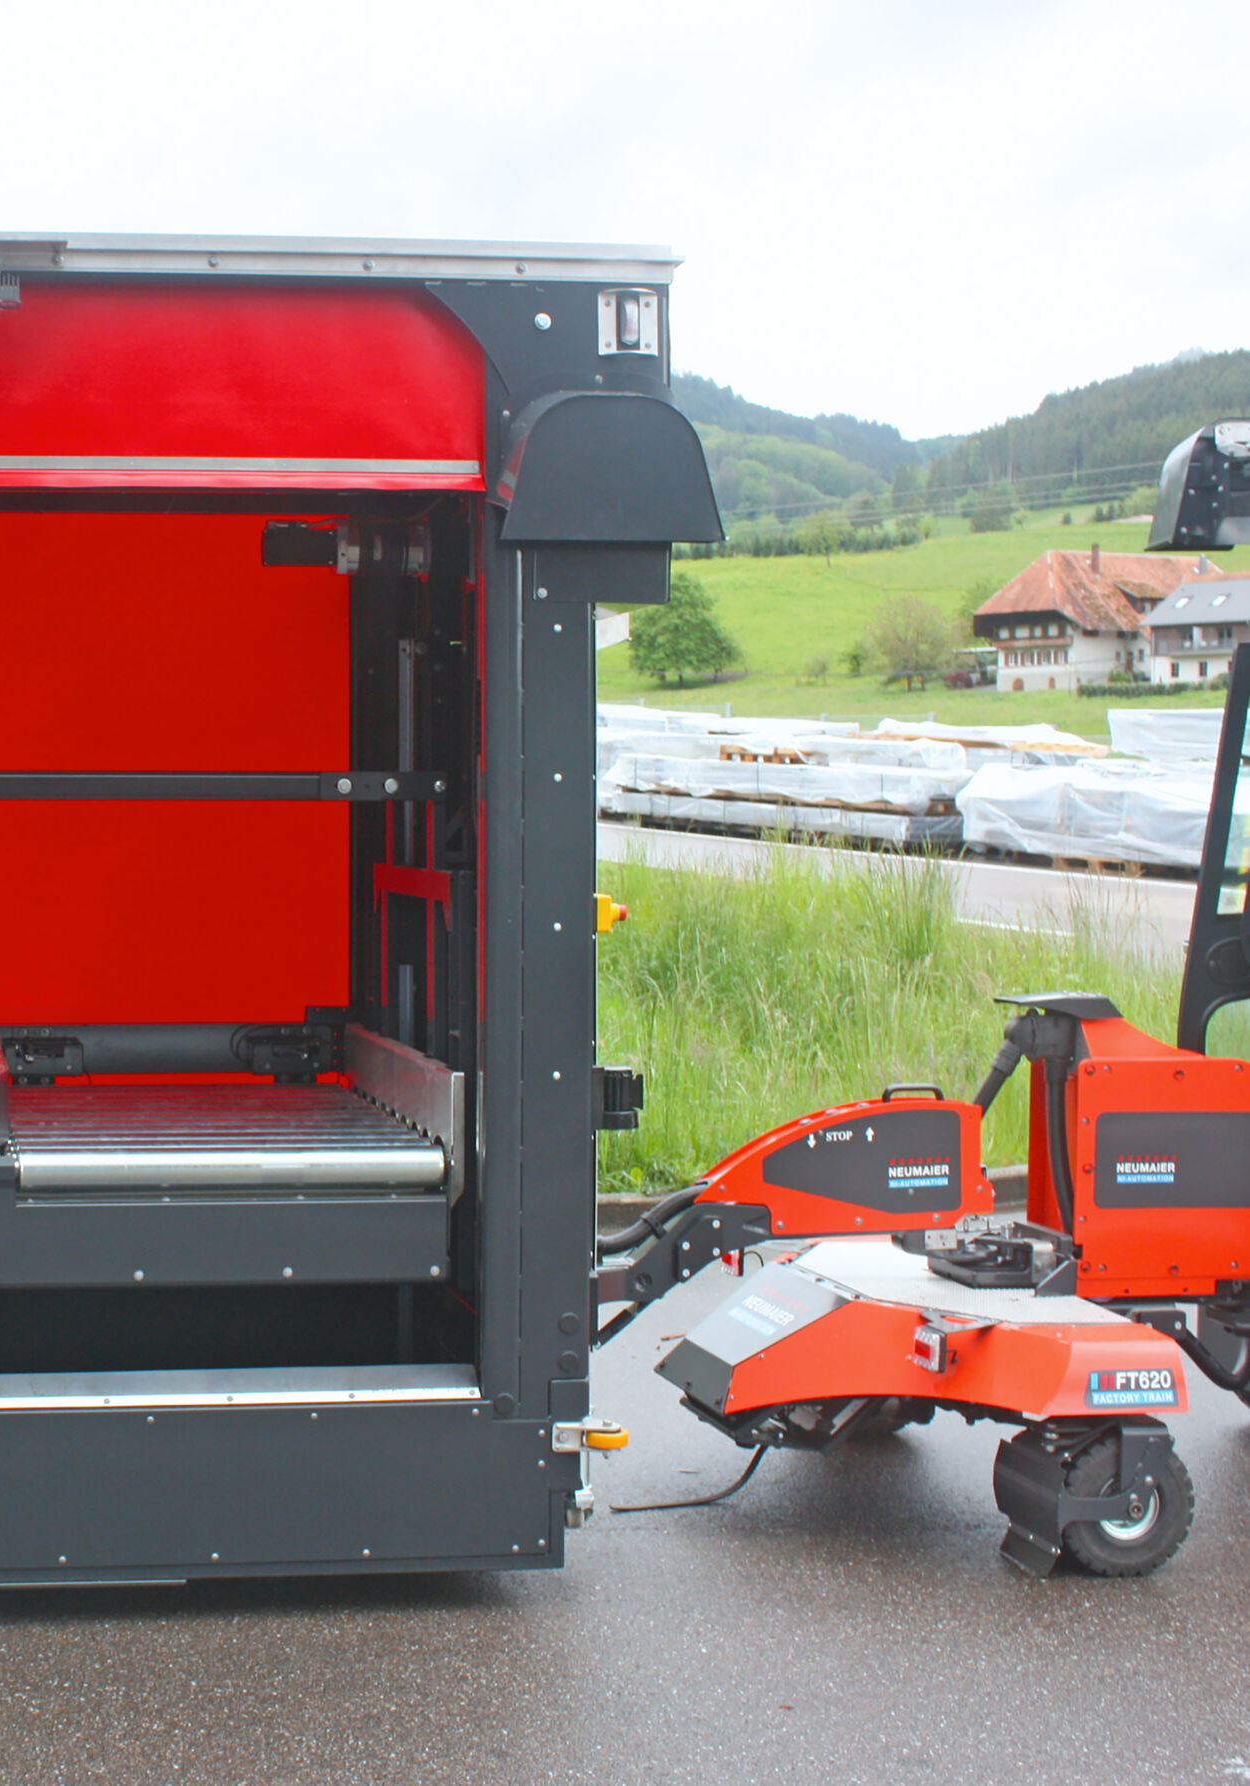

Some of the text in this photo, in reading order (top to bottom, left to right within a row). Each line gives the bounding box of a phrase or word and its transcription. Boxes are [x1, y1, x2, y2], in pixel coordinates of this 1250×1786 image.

[825, 1131, 853, 1142] STOP
[888, 1164, 949, 1178] NEUMAIER
[1116, 1162, 1175, 1173] NEUMAIER
[1116, 1371, 1171, 1390] FT620
[1093, 1391, 1173, 1405] FACTORY TRAIN
